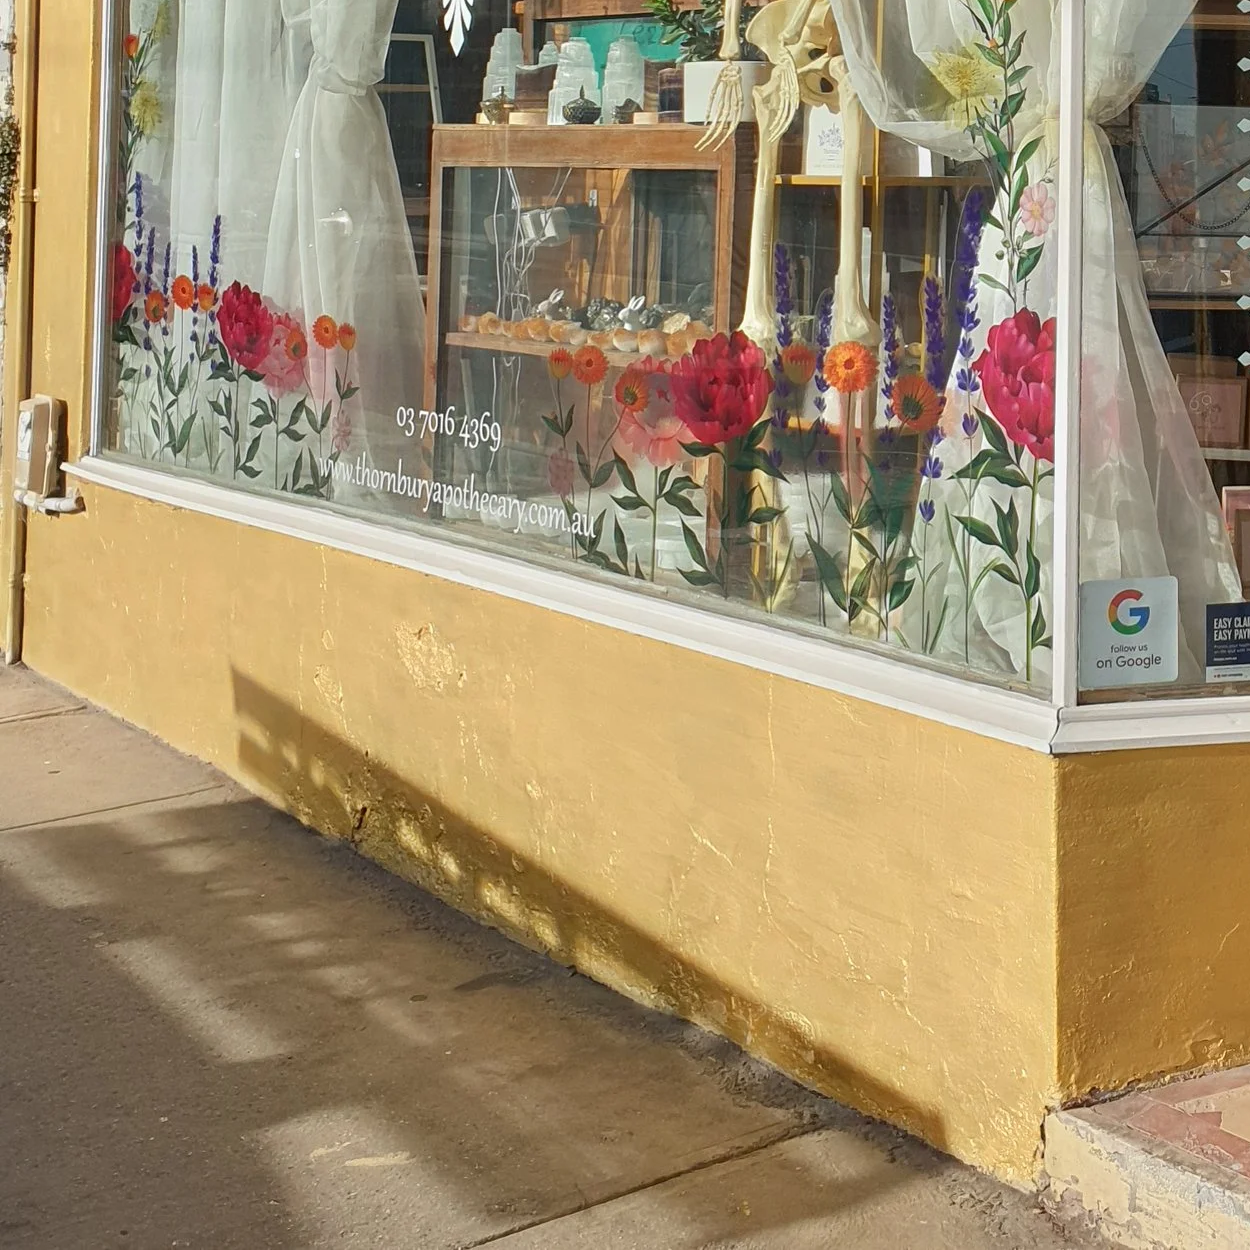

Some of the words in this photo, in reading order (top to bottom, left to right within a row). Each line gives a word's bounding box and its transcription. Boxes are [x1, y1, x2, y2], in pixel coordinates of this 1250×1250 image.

[396, 406, 414, 437] 03
[420, 406, 455, 440] 7016
[459, 411, 501, 451] 4369
[319, 452, 597, 538] www.thornburyapothecary.com.au
[1213, 617, 1231, 630] EASY
[1213, 629, 1231, 642] EASY
[1110, 643, 1134, 654] follow
[1138, 643, 1148, 652] us
[1096, 657, 1113, 669] on
[1115, 654, 1161, 669] Google
